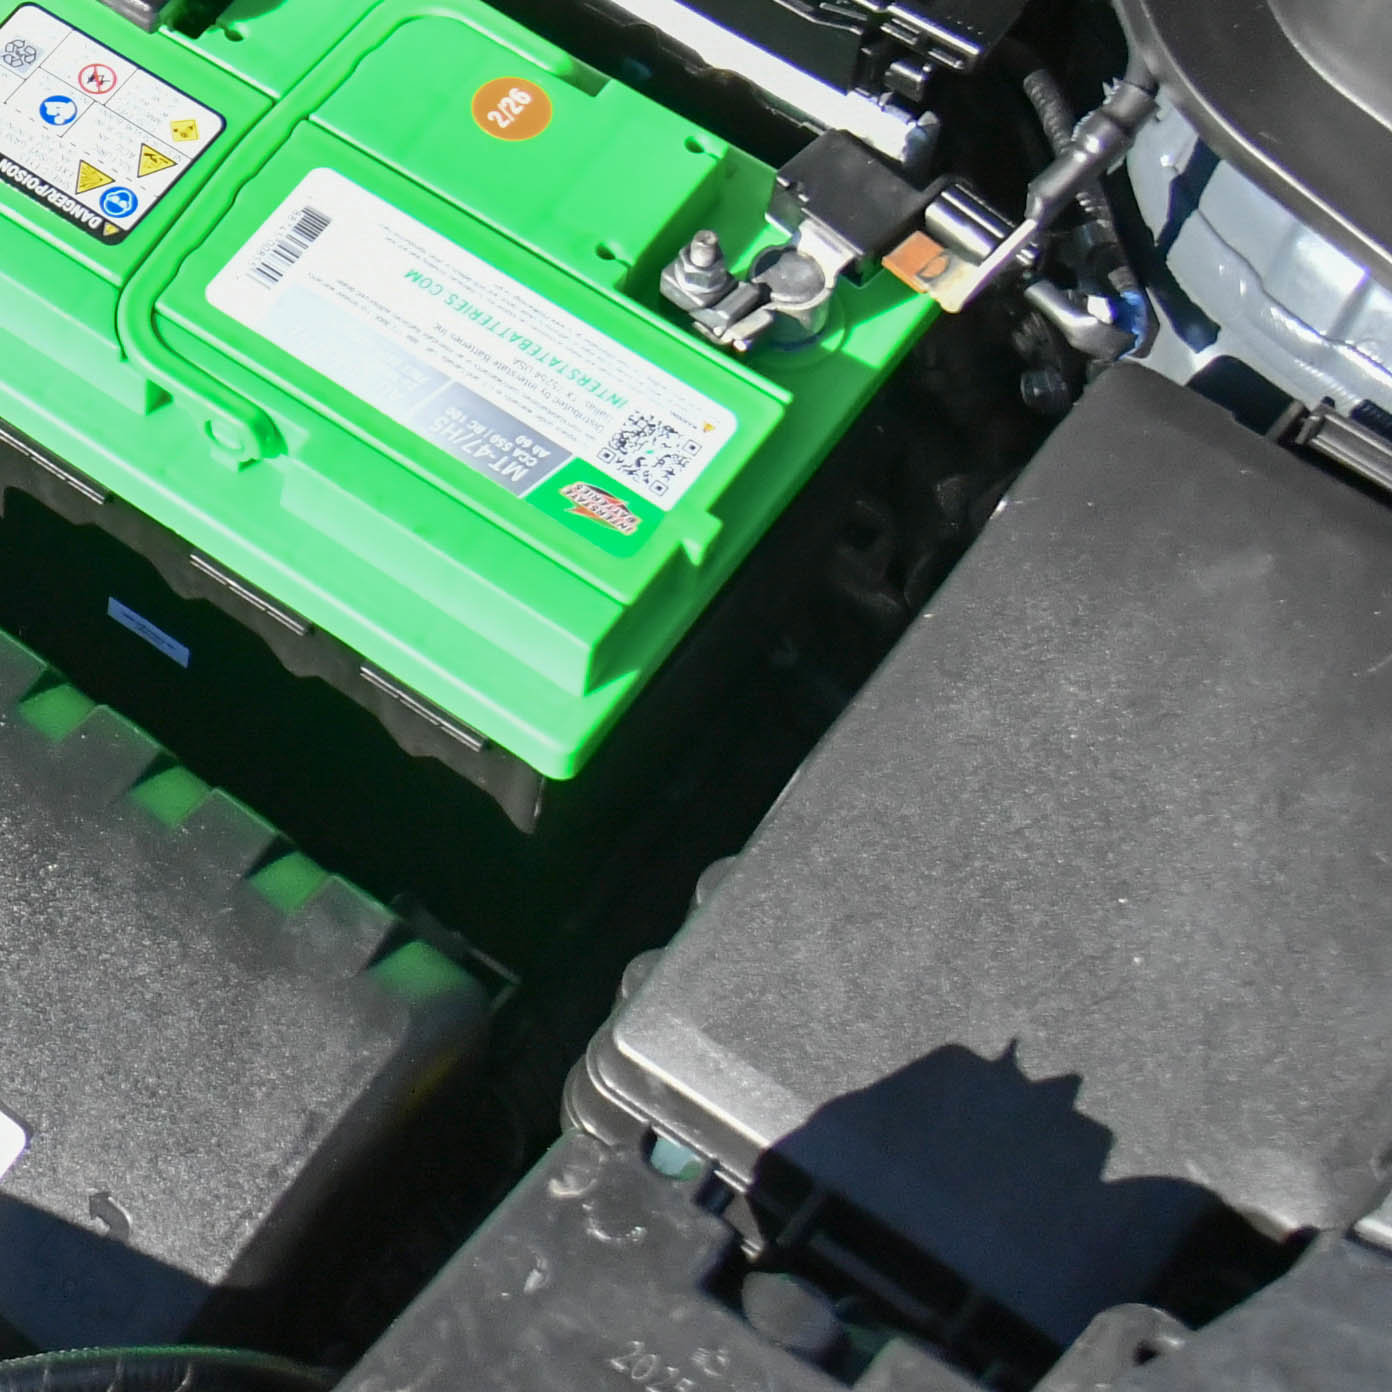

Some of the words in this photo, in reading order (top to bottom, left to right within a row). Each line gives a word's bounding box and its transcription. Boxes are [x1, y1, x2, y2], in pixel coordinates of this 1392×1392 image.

[487, 88, 532, 128] 2/26
[513, 447, 539, 467] CCA
[563, 487, 635, 534] INTERSTATE
[574, 483, 636, 525] BATTERIES
